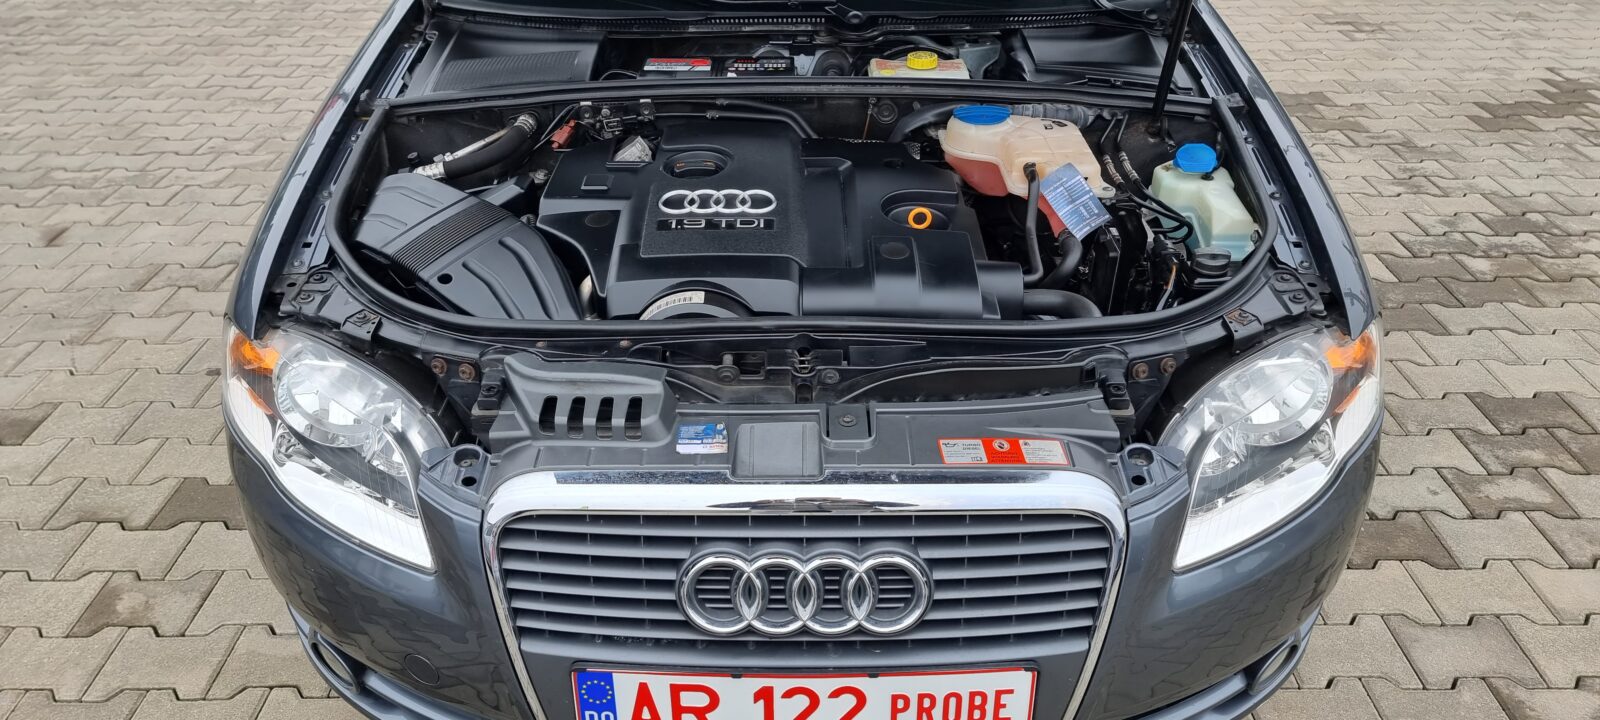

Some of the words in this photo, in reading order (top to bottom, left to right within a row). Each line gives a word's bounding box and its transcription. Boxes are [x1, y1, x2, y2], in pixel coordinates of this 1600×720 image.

[668, 218, 706, 229] 1.9
[712, 218, 765, 228] TDI
[630, 681, 721, 720] AR
[753, 685, 868, 720] 122
[890, 688, 1015, 720] PROBE
